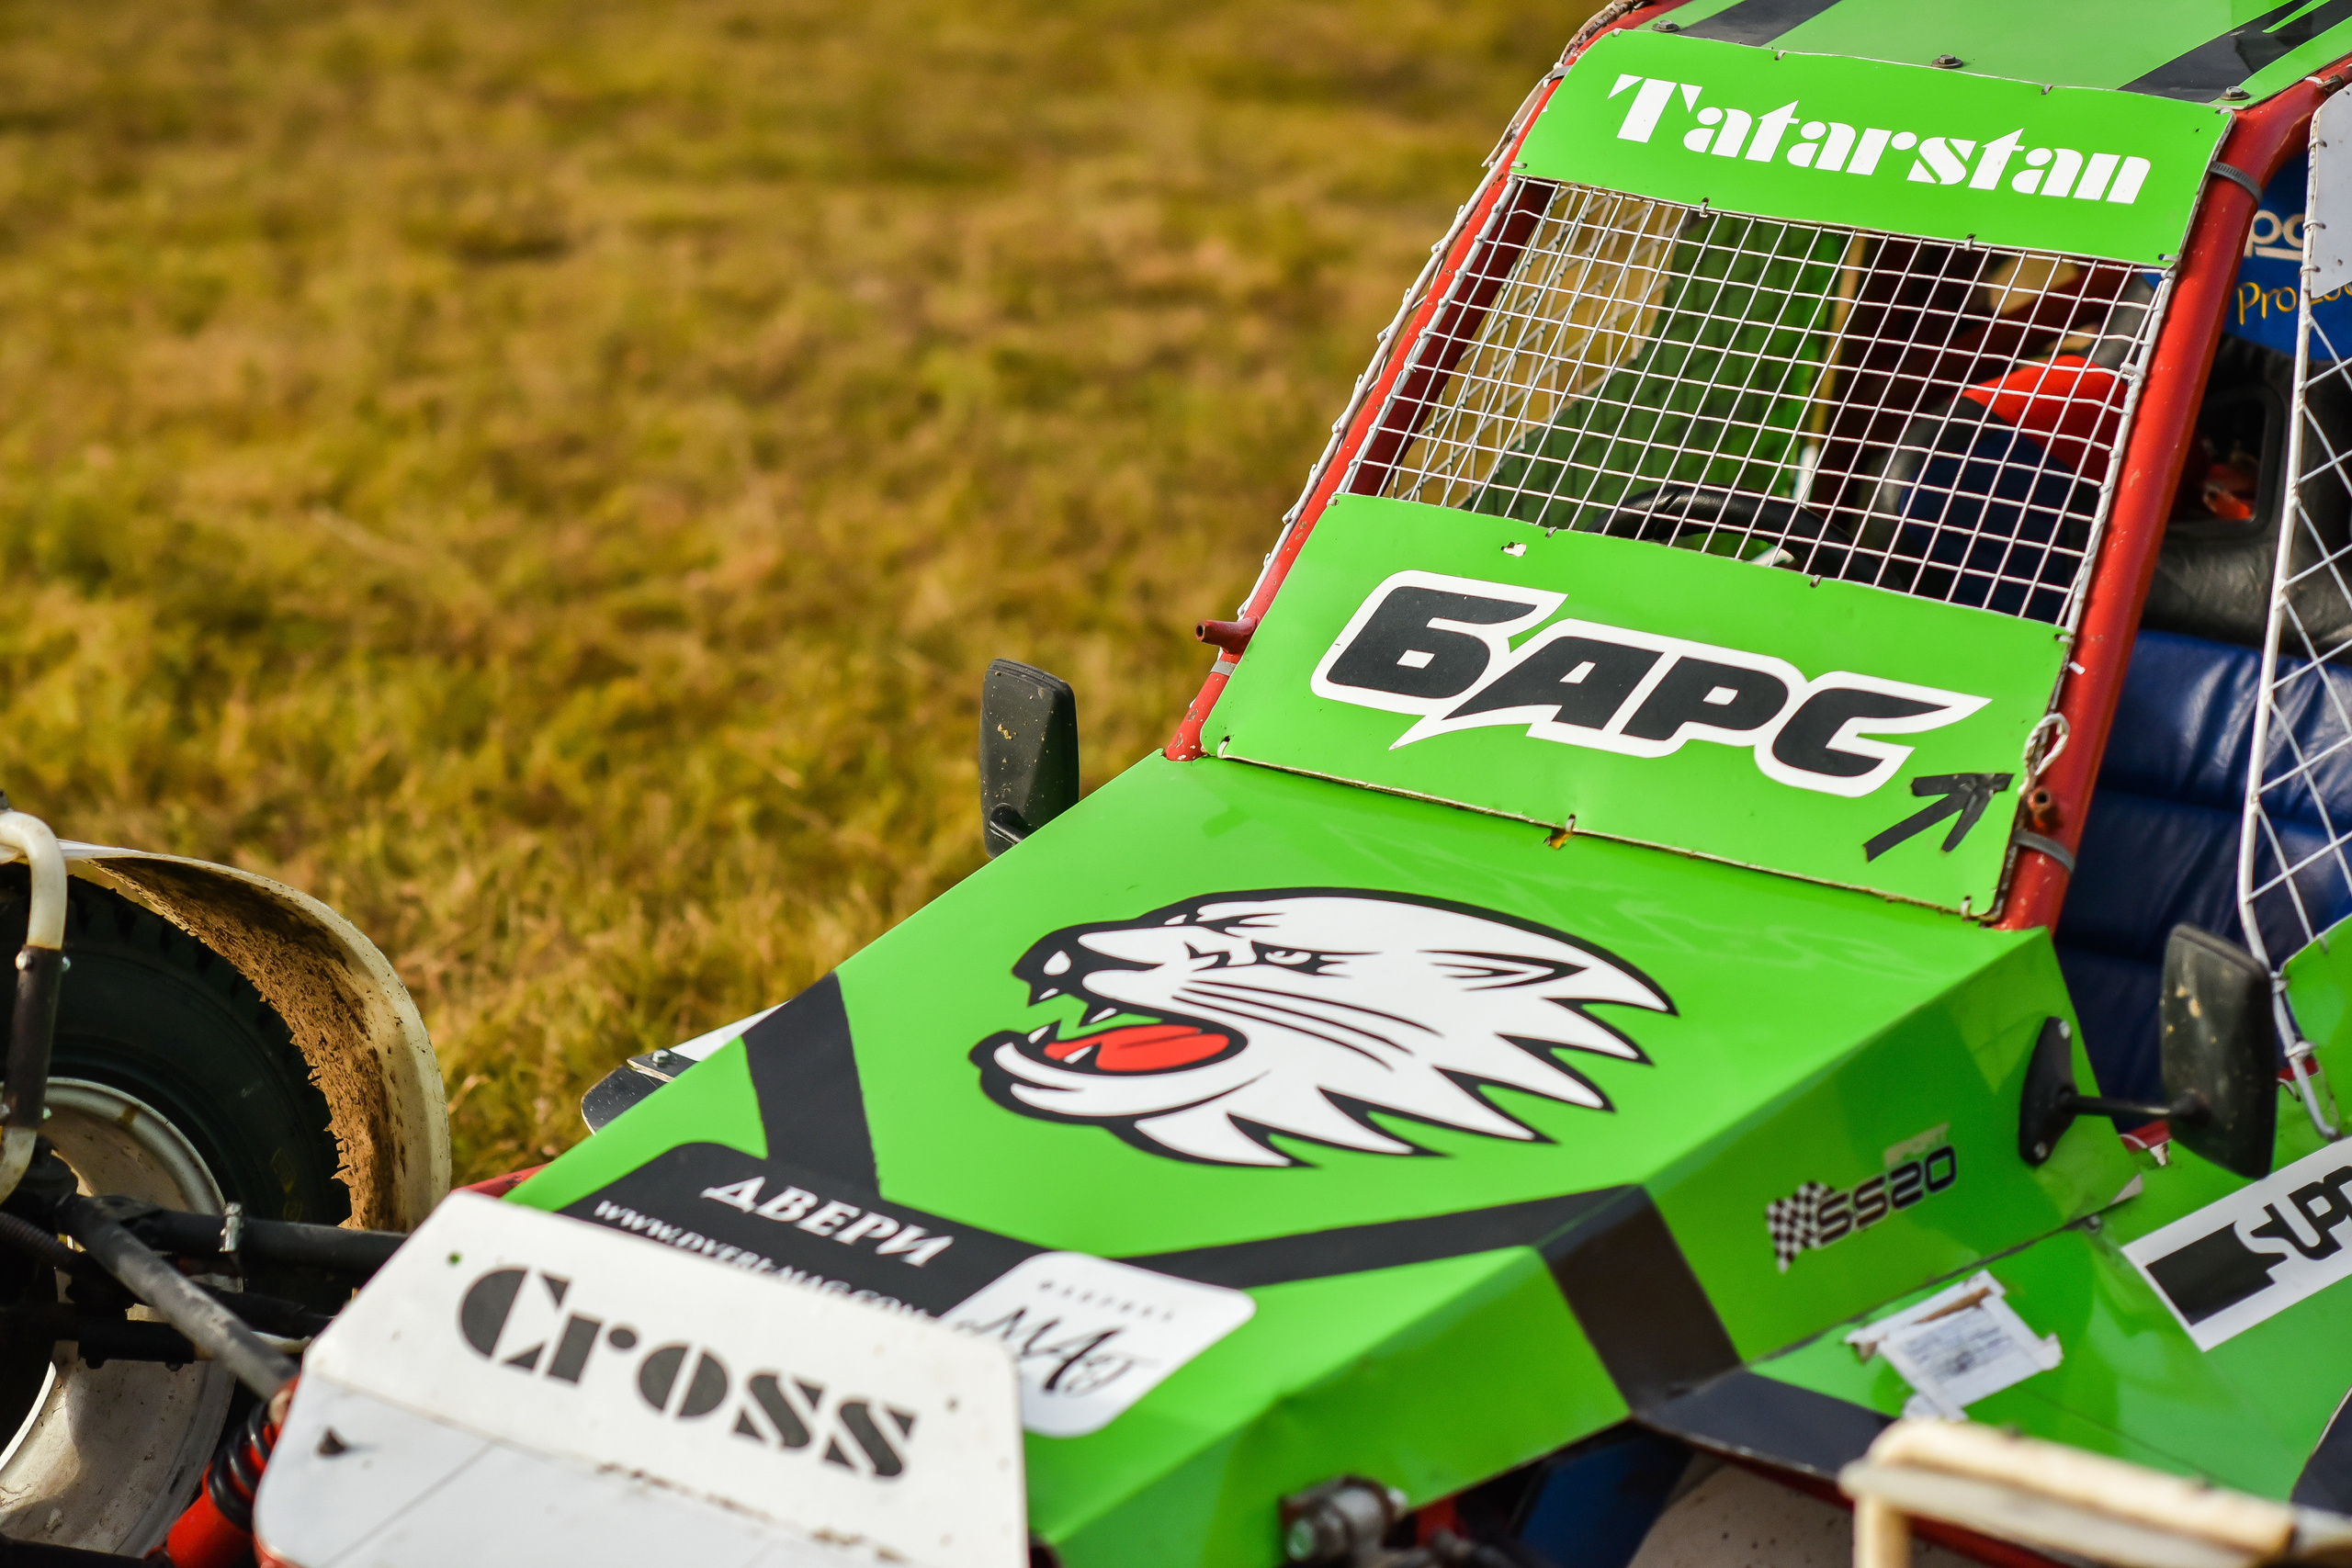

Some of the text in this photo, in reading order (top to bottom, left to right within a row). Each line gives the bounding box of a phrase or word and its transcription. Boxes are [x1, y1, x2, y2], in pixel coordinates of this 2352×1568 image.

[1606, 73, 2153, 205] Tatarstan
[1321, 581, 1961, 783] БАРС
[699, 1176, 956, 1268] ДВЕРИ
[1815, 1145, 1958, 1245] SS20
[456, 1266, 918, 1480] Cross
